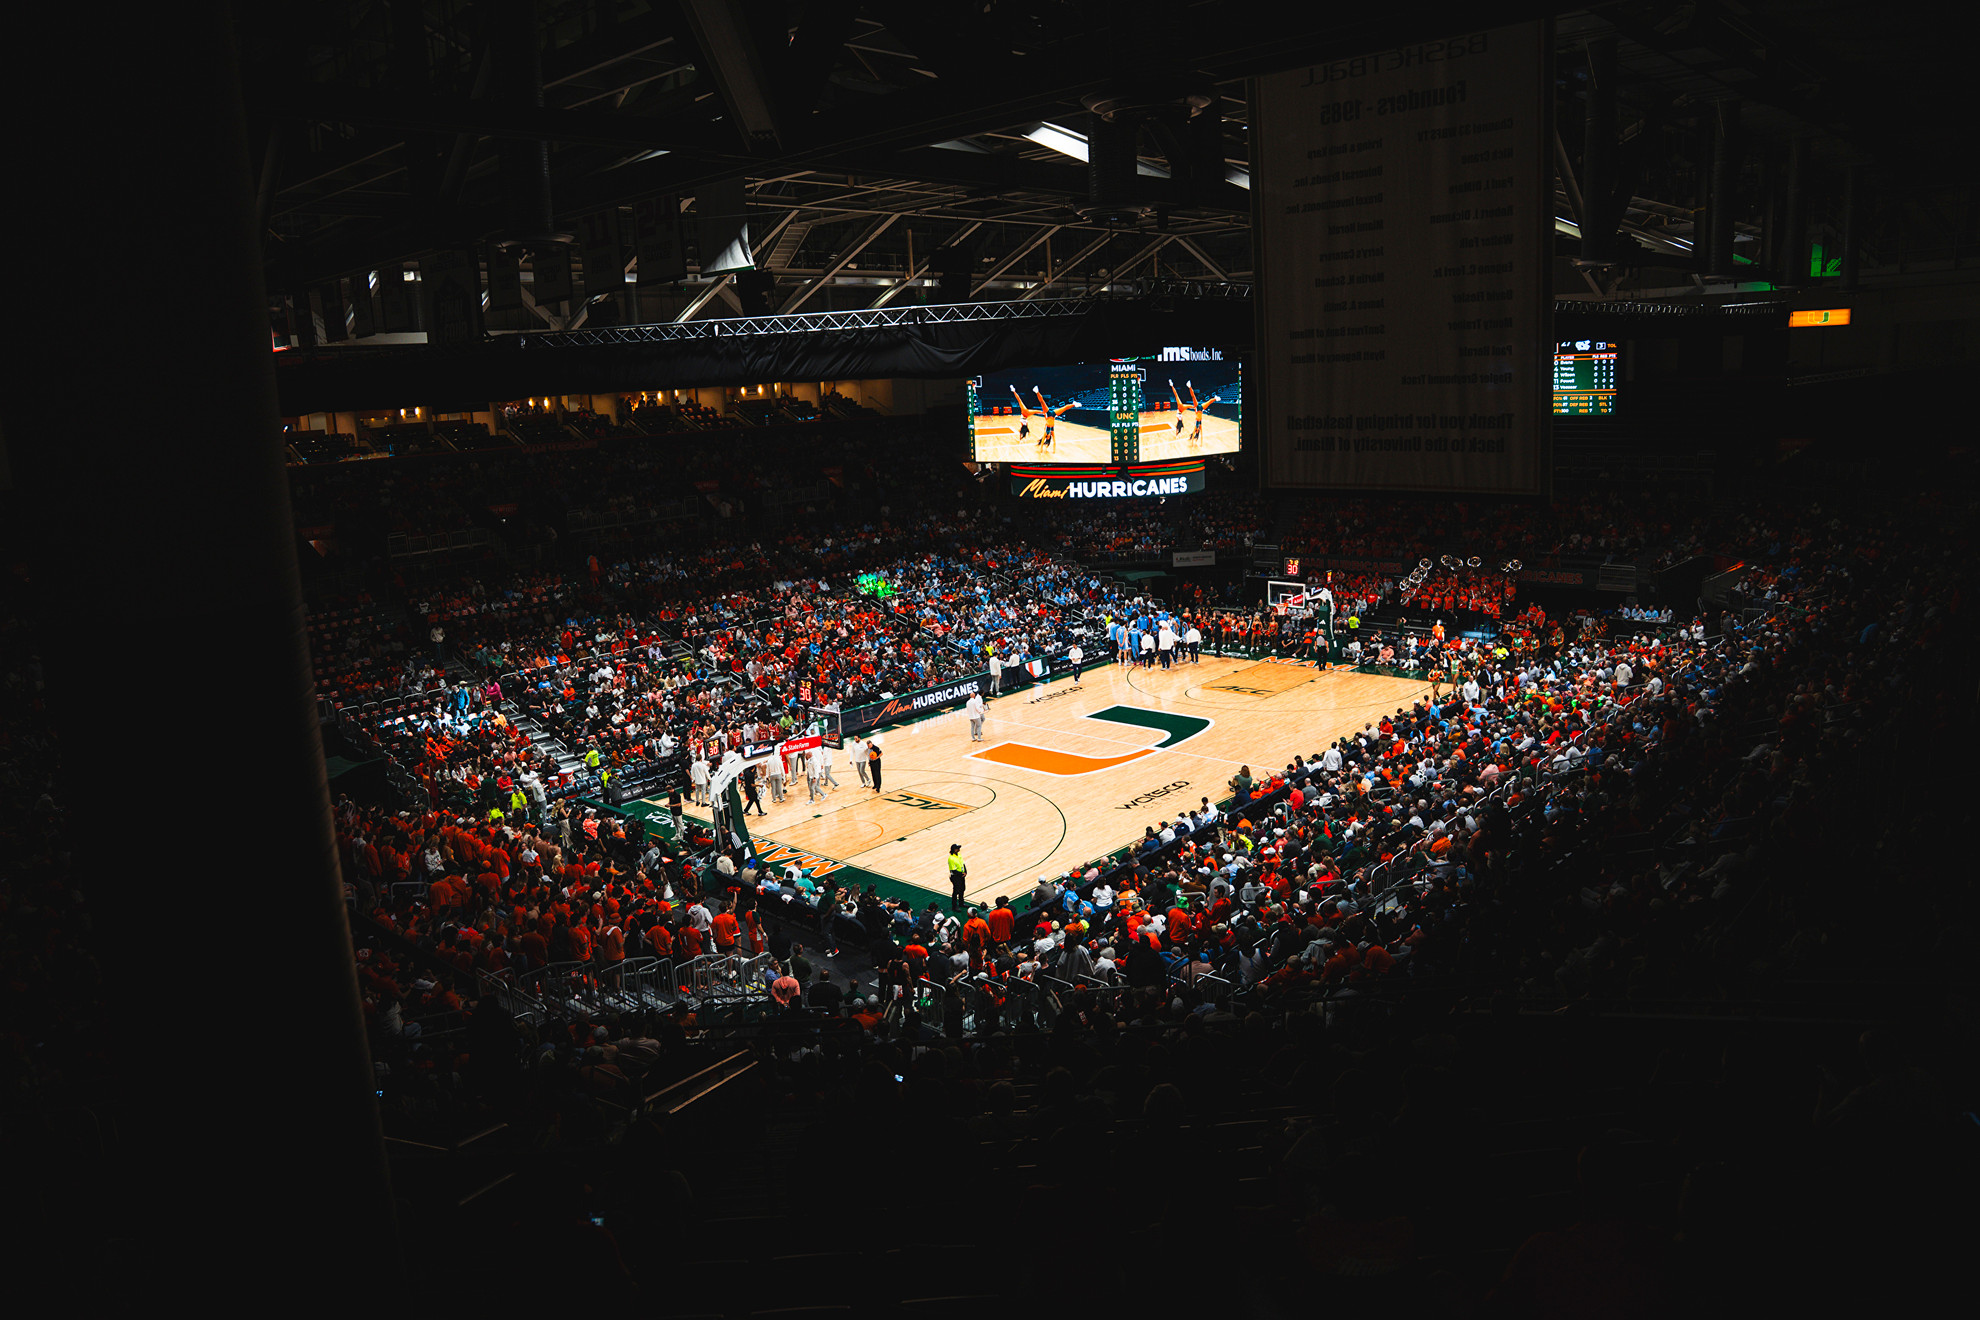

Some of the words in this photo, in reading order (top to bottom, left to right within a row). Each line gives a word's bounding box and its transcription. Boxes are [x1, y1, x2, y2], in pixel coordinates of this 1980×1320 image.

[638, 195, 674, 238] 24
[583, 212, 612, 250] 11
[1111, 364, 1136, 372] MIAMI
[1020, 478, 1070, 499] Miami
[1069, 476, 1188, 498] HURRICANES
[1287, 564, 1298, 575] 30
[800, 688, 812, 702] 30
[912, 681, 979, 710] HURRICANES
[1211, 685, 1274, 696] ACC
[708, 746, 718, 756] 30
[882, 794, 959, 810] ACC
[1114, 780, 1190, 810] watsco
